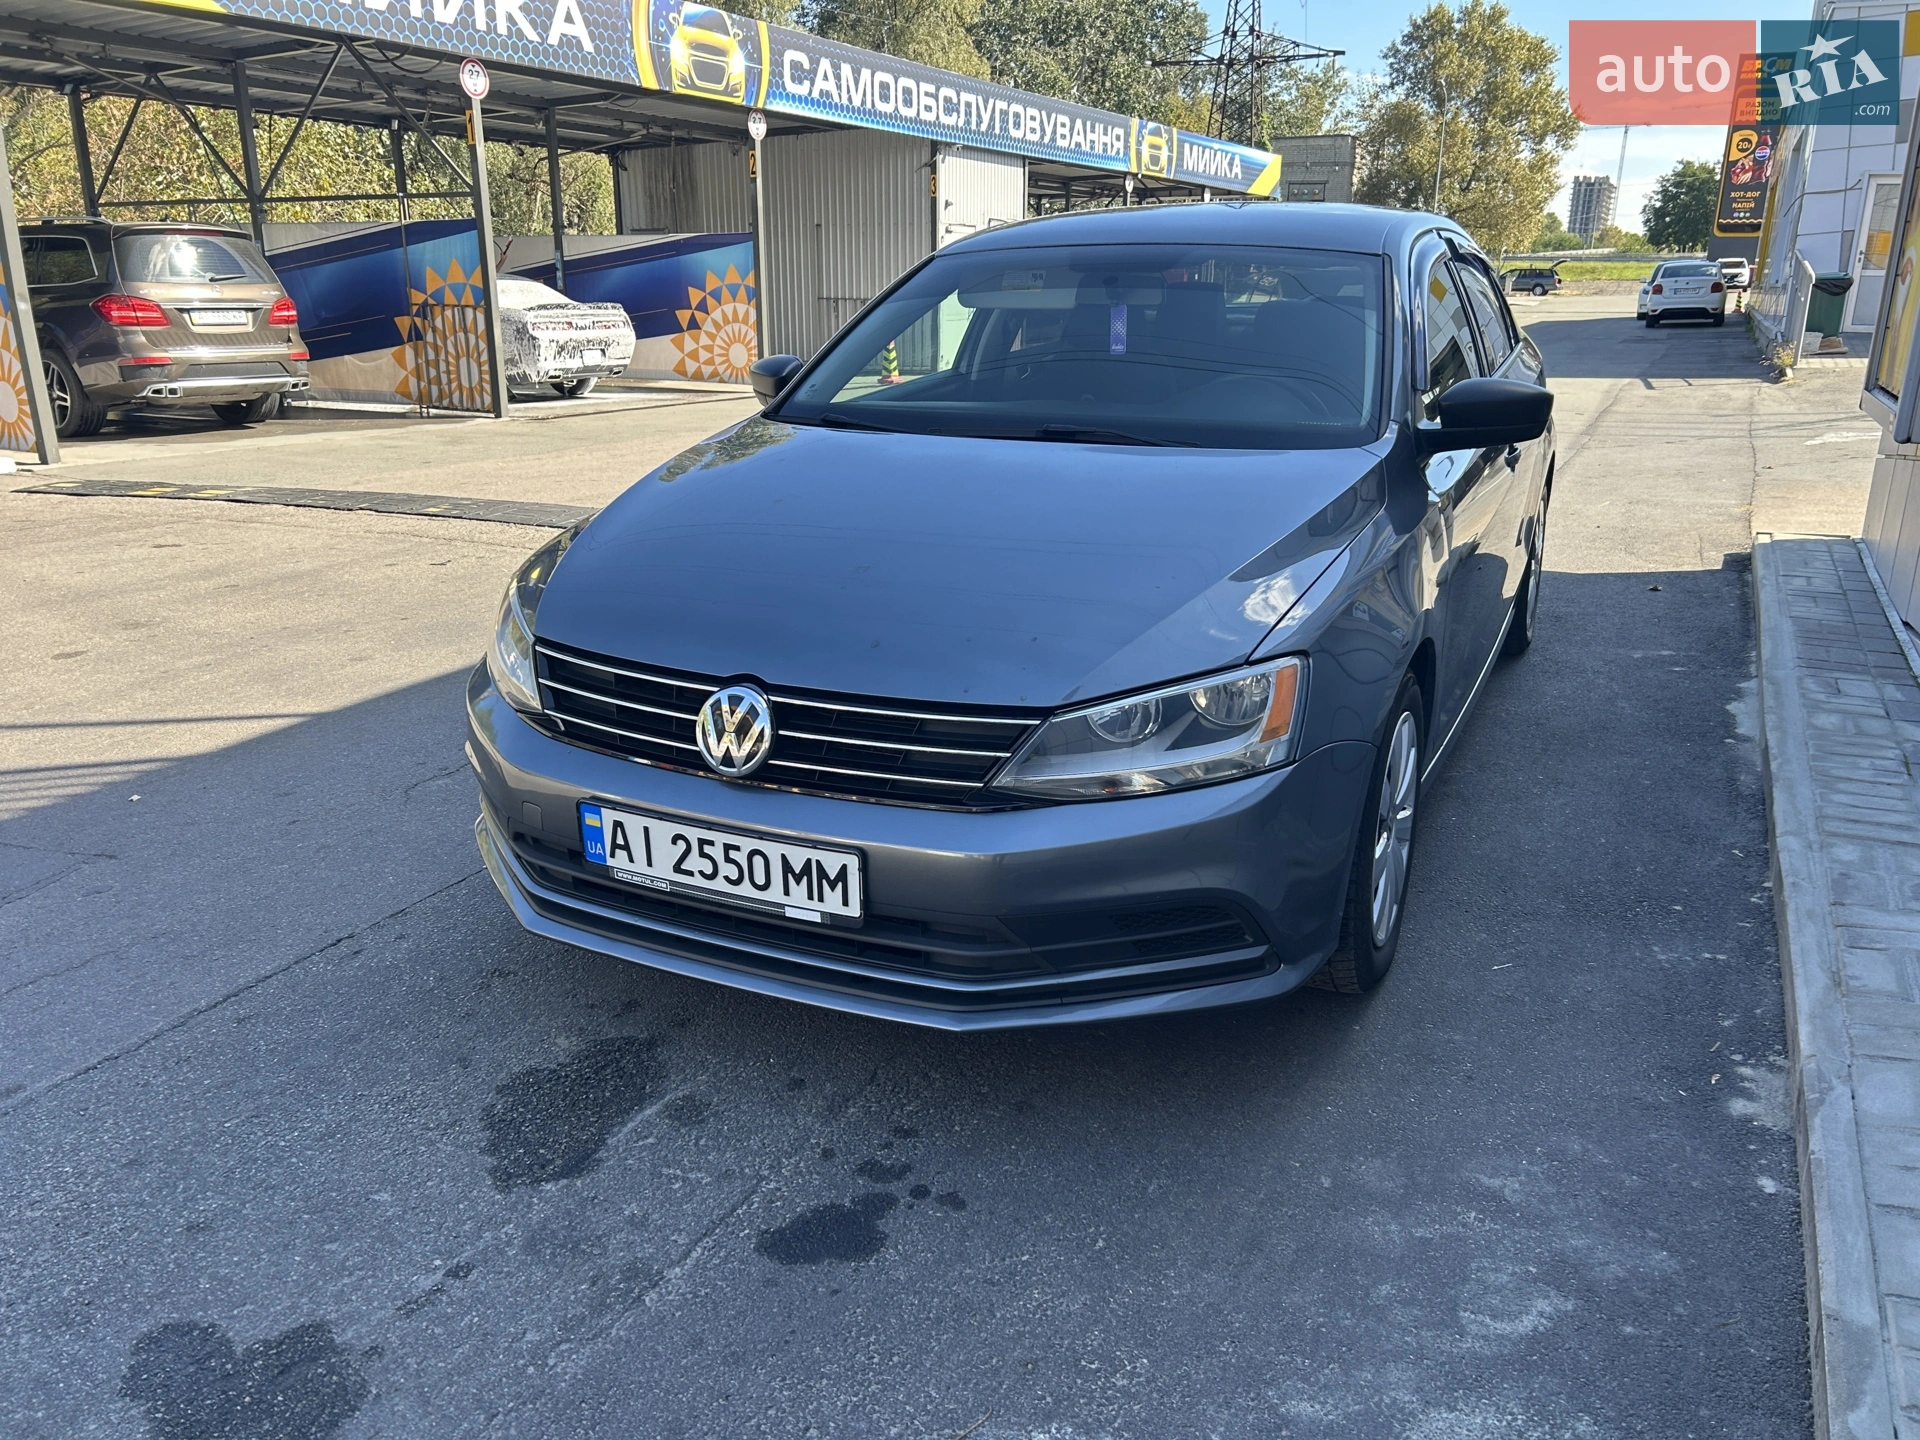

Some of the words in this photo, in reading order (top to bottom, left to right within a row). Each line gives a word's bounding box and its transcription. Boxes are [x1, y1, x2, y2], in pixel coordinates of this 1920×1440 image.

[783, 49, 1125, 158] САМООБСЛУГОВУВАННЯ
[1739, 109, 1779, 117] ВИГІДНО
[467, 113, 474, 142] 1
[750, 152, 756, 175] 2
[1183, 142, 1242, 180] МИЙКА
[931, 176, 937, 195] 3
[587, 841, 604, 856] UA
[609, 819, 653, 868] AI
[670, 832, 772, 892] 2550
[780, 853, 849, 907] MM
